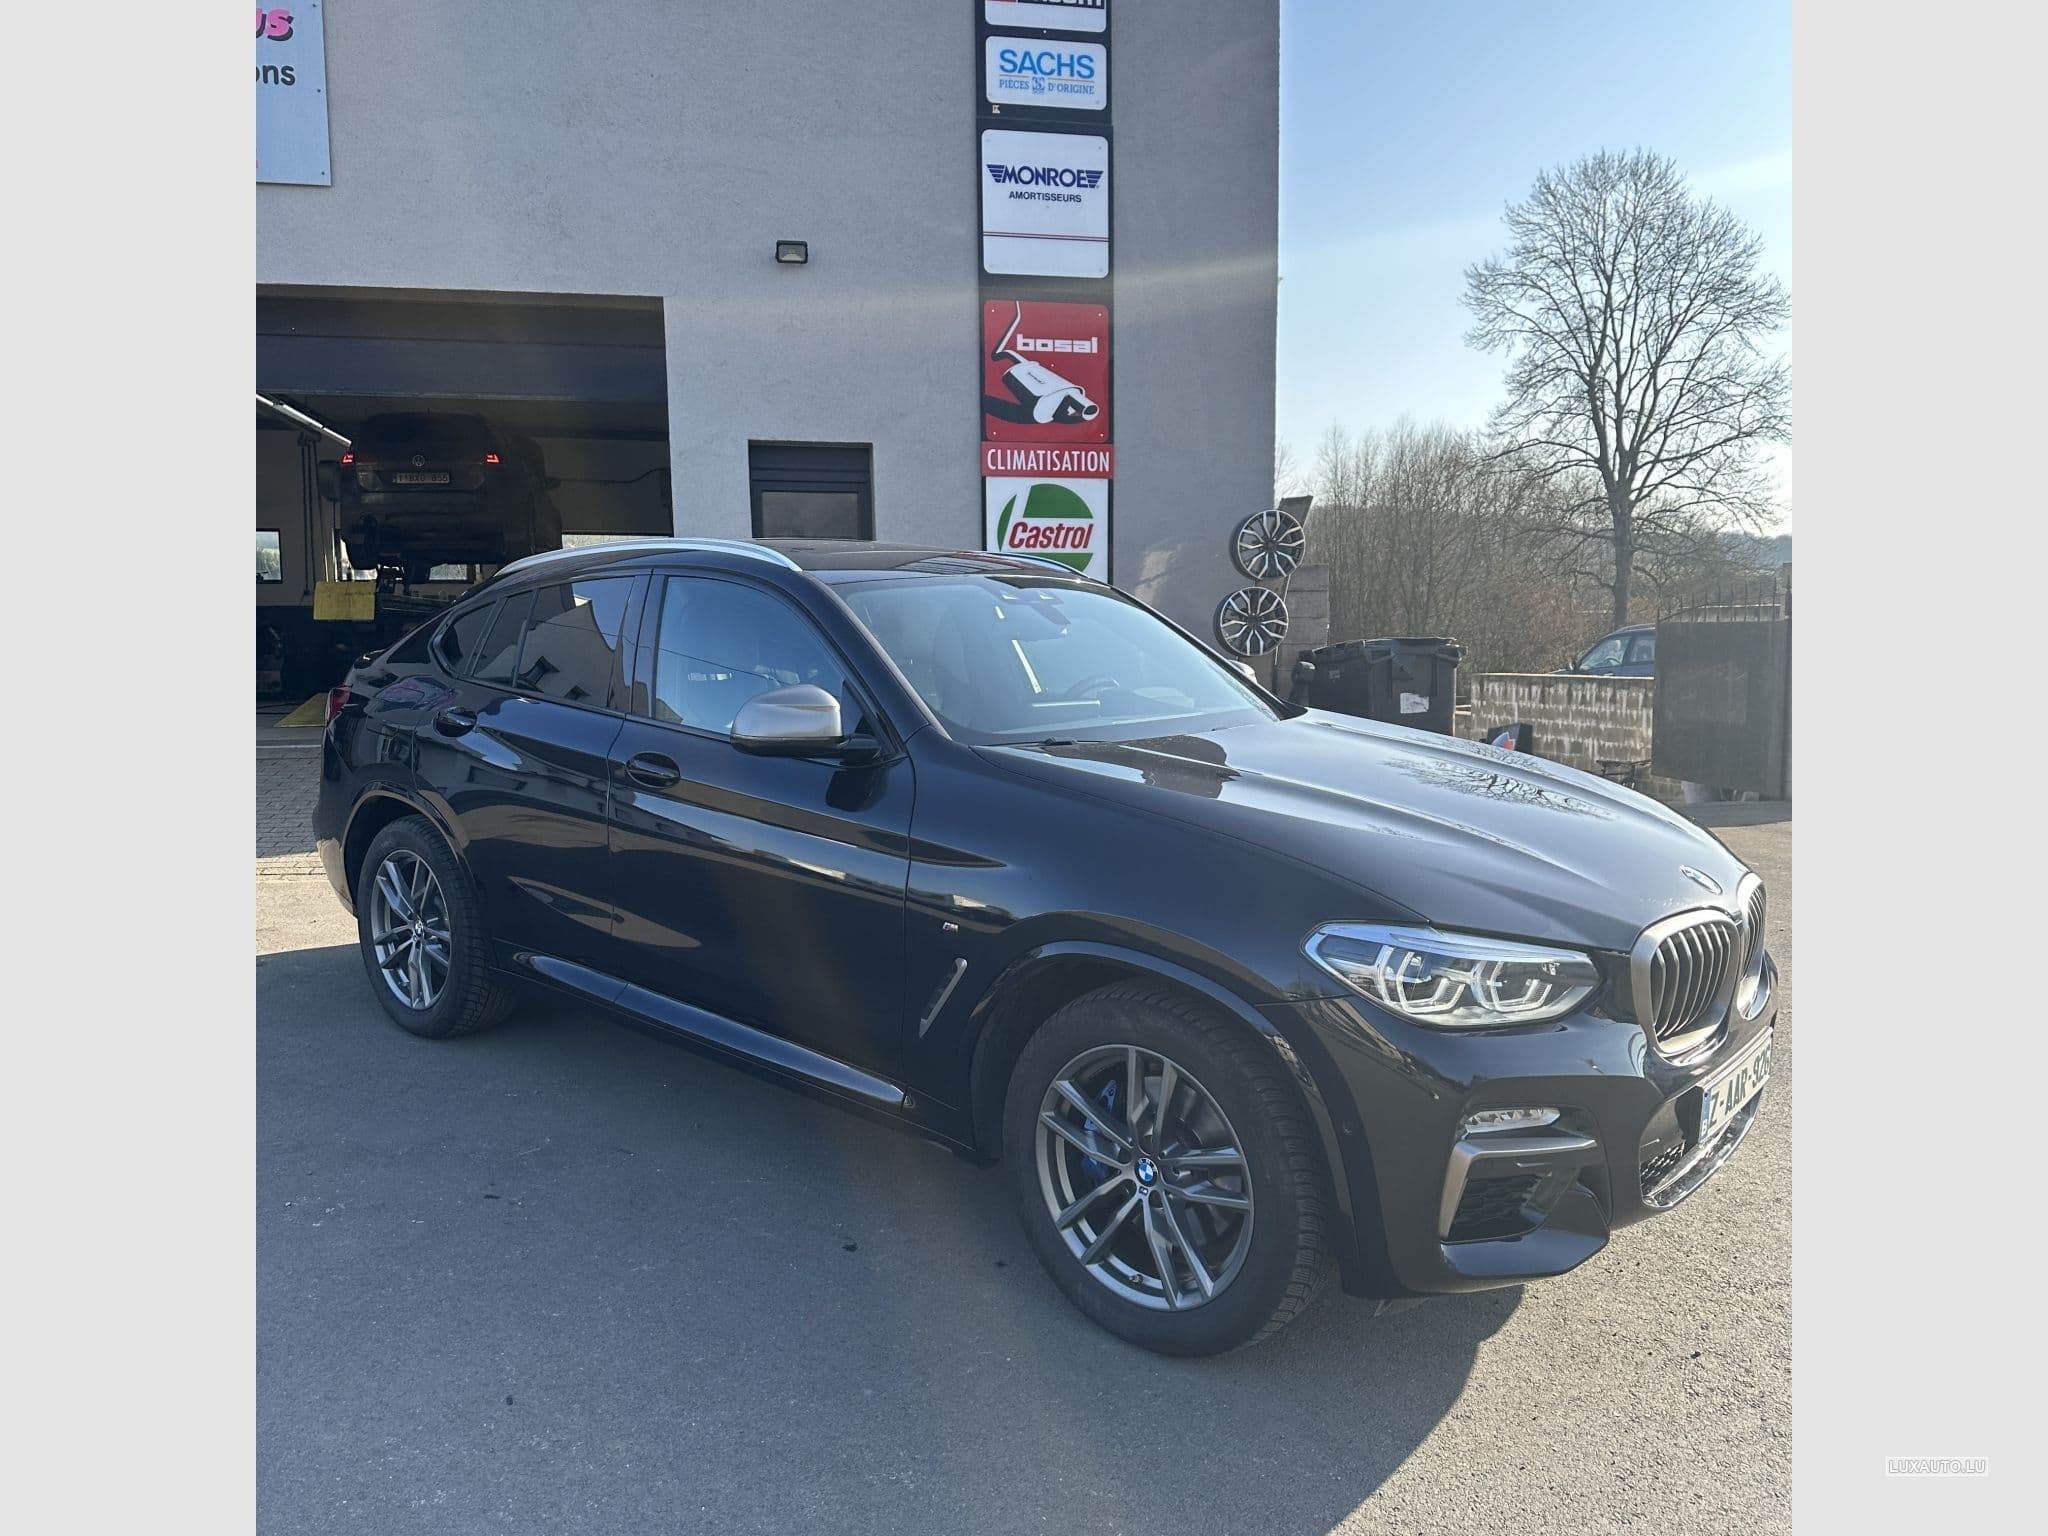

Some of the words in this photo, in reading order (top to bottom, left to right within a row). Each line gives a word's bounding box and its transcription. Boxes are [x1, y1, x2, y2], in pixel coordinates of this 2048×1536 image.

[999, 49, 1095, 79] SACHS
[256, 65, 296, 86] ns
[1048, 82, 1095, 95] D'ORIGINE
[1002, 165, 1089, 188] MONROE
[1008, 191, 1082, 202] AMORTISSEURS
[1016, 333, 1098, 353] bosal
[987, 448, 1110, 472] CLIMATISATION
[1008, 521, 1094, 549] Castrol
